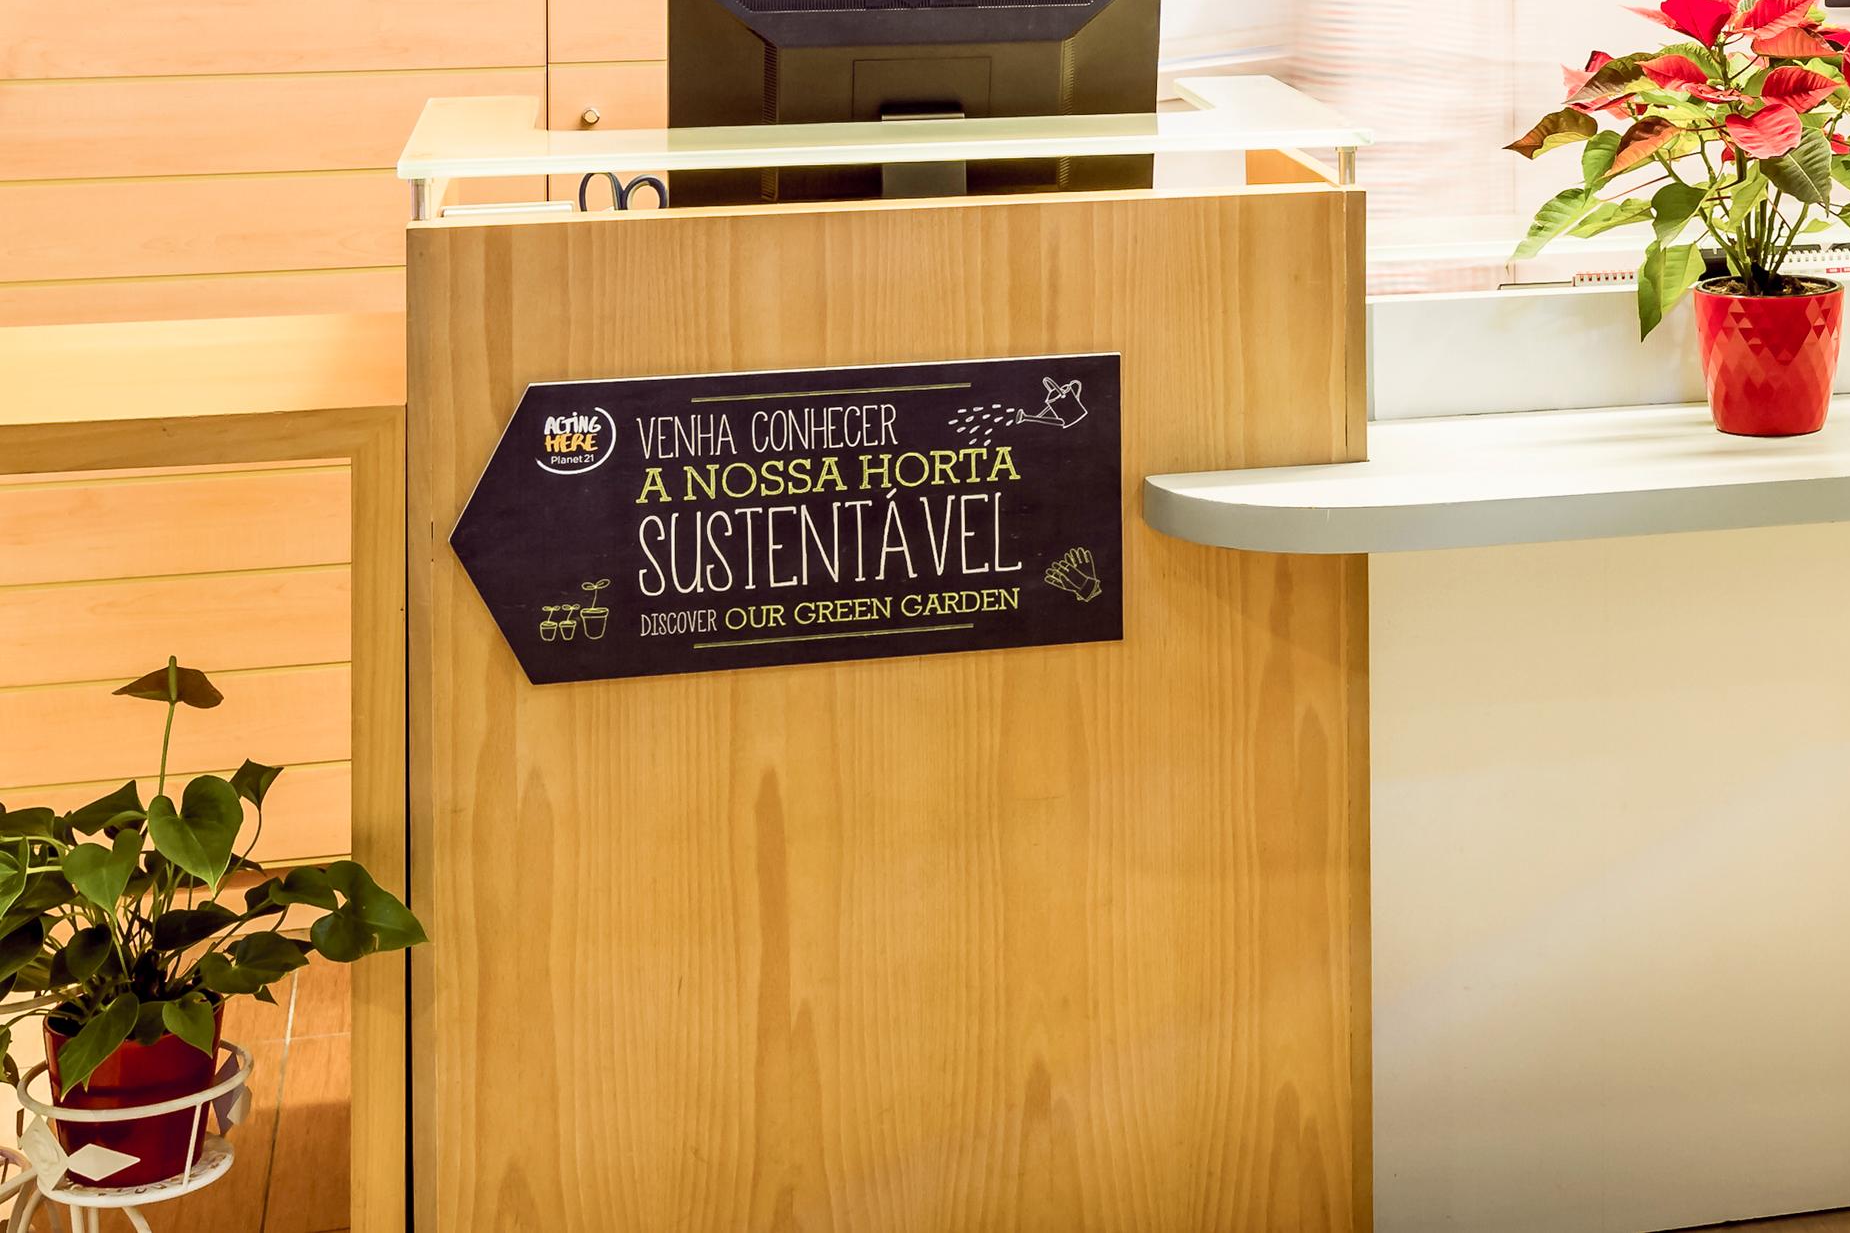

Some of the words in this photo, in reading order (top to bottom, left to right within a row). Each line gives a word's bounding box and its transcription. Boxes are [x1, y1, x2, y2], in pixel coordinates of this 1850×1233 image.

[544, 433, 599, 453] HERE
[636, 414, 738, 460] VENHA
[751, 403, 899, 453] CONHECER
[550, 455, 583, 465] Planet
[584, 453, 595, 463] 21
[635, 467, 673, 504] A
[683, 456, 848, 500] NOSSA
[858, 446, 1022, 490] HORTA
[638, 487, 1022, 597] SUSTENTÁVEL
[640, 608, 718, 637] DISCOVER
[725, 604, 787, 630] OUR
[793, 596, 893, 625] GREEN
[901, 587, 1021, 617] GARDEN
